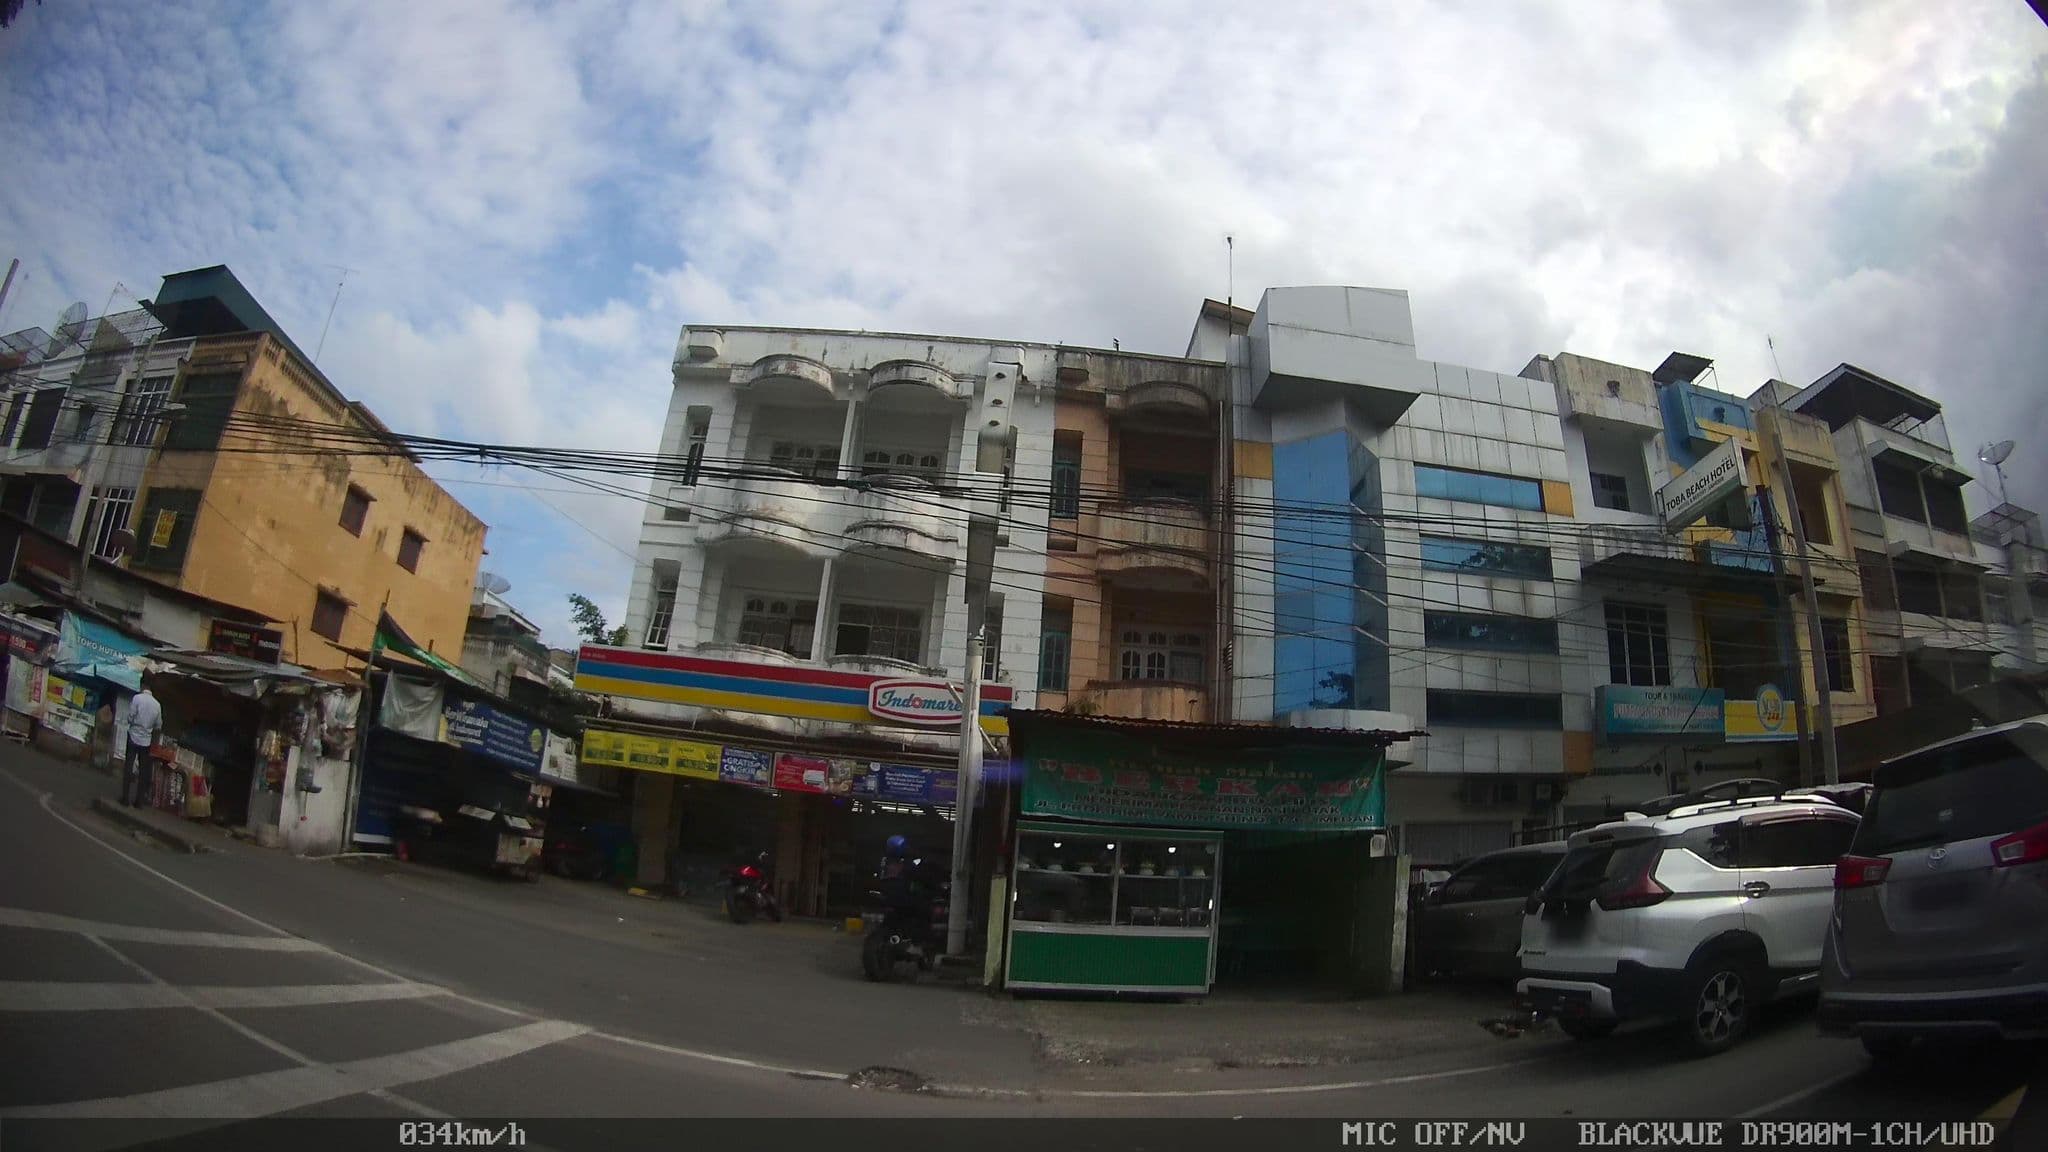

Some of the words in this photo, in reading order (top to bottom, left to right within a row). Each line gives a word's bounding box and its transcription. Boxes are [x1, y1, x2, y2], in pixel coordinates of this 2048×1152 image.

[1666, 493, 1686, 512] TOBA
[1686, 476, 1710, 498] BEACH
[1710, 458, 1735, 481] HOTEL
[77, 635, 98, 650] TOKO
[878, 689, 963, 712] Indomare
